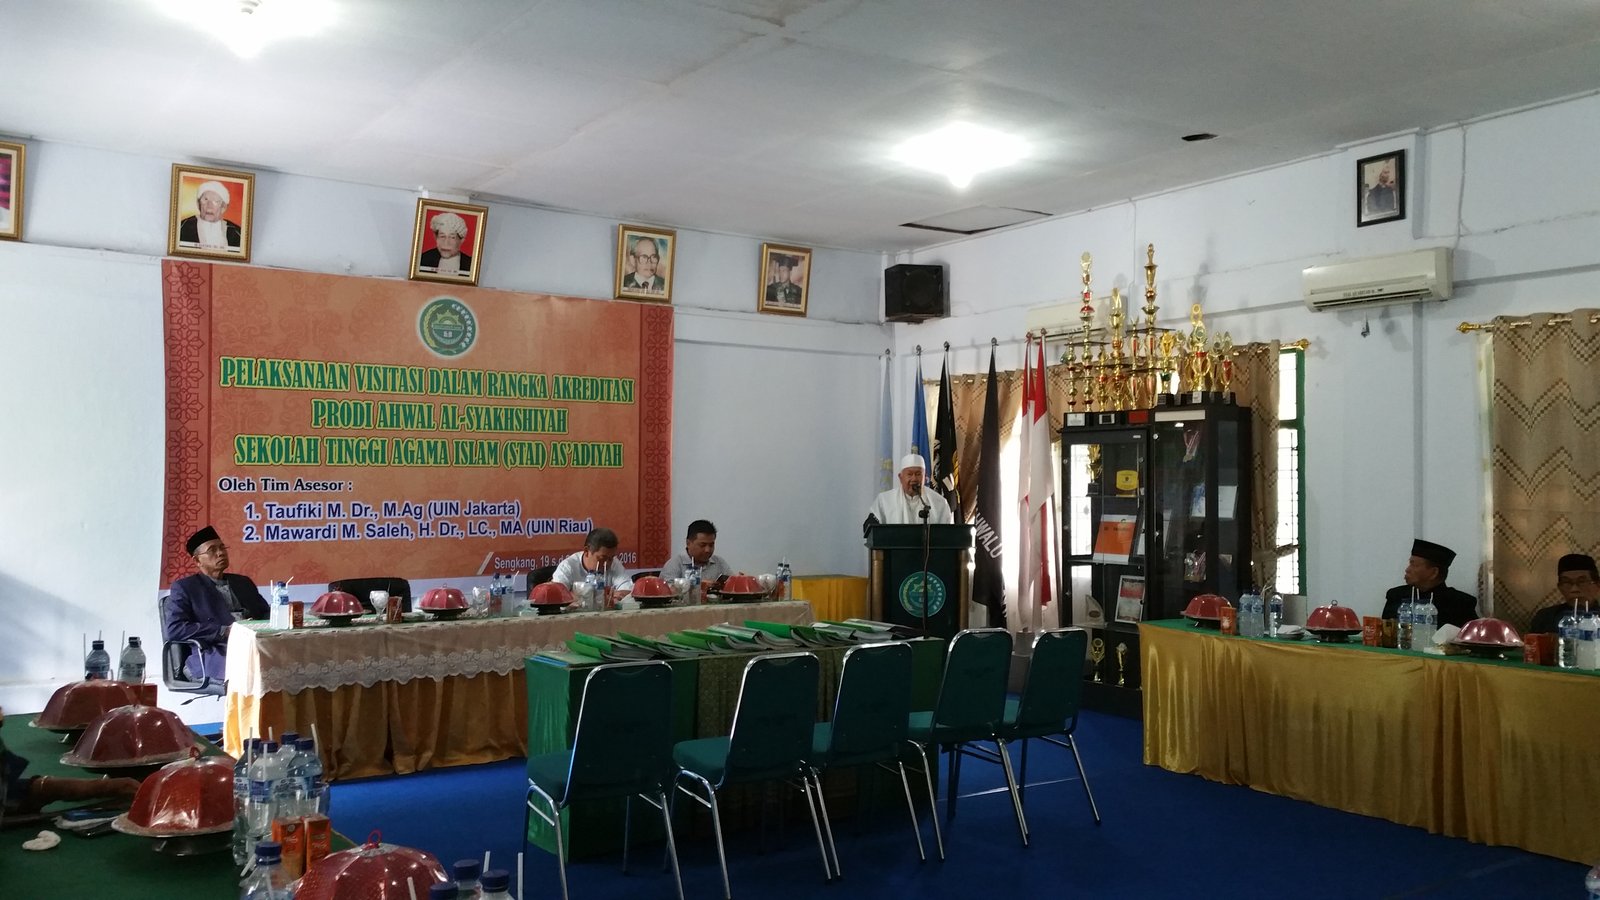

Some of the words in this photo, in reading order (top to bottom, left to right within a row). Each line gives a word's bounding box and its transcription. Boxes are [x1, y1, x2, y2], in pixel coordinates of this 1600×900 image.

[220, 356, 350, 391] PELAKSANAAN
[354, 364, 425, 394] VISITASI
[428, 368, 483, 397] DALAM
[487, 371, 549, 399] RANGKA
[552, 375, 635, 403] AKREDITASI
[311, 399, 373, 428] PRODI
[376, 401, 436, 430] AHWAL
[440, 403, 568, 434] AL-SYAKHSHIYAH
[234, 434, 320, 465] SEKOLAH
[324, 436, 388, 466] TINGGI
[392, 438, 450, 466] AGAMA
[453, 439, 500, 466] ISLAM
[219, 478, 256, 491] Oleh
[261, 478, 289, 491] Tim
[293, 478, 344, 491] Asesor
[244, 503, 260, 519] 1.
[265, 503, 322, 519] Taufiki
[327, 503, 346, 518] M.
[351, 503, 378, 520] Dr.,
[383, 502, 423, 520] M.Ag
[427, 501, 460, 519] (UIN
[464, 500, 521, 519] Jakarta)
[243, 525, 260, 541] 2.
[265, 524, 337, 541] Mawardi
[341, 523, 360, 539] M.
[365, 522, 414, 541] Saleh,
[419, 523, 435, 537] H.
[439, 521, 464, 539] Dr.,
[468, 521, 496, 538] LC.,
[500, 520, 523, 535] MA
[526, 520, 555, 538] (UIN
[559, 519, 592, 534] Riau)
[494, 556, 538, 571] Sengkang,
[541, 555, 549, 567] 19
[619, 552, 637, 563] 2016
